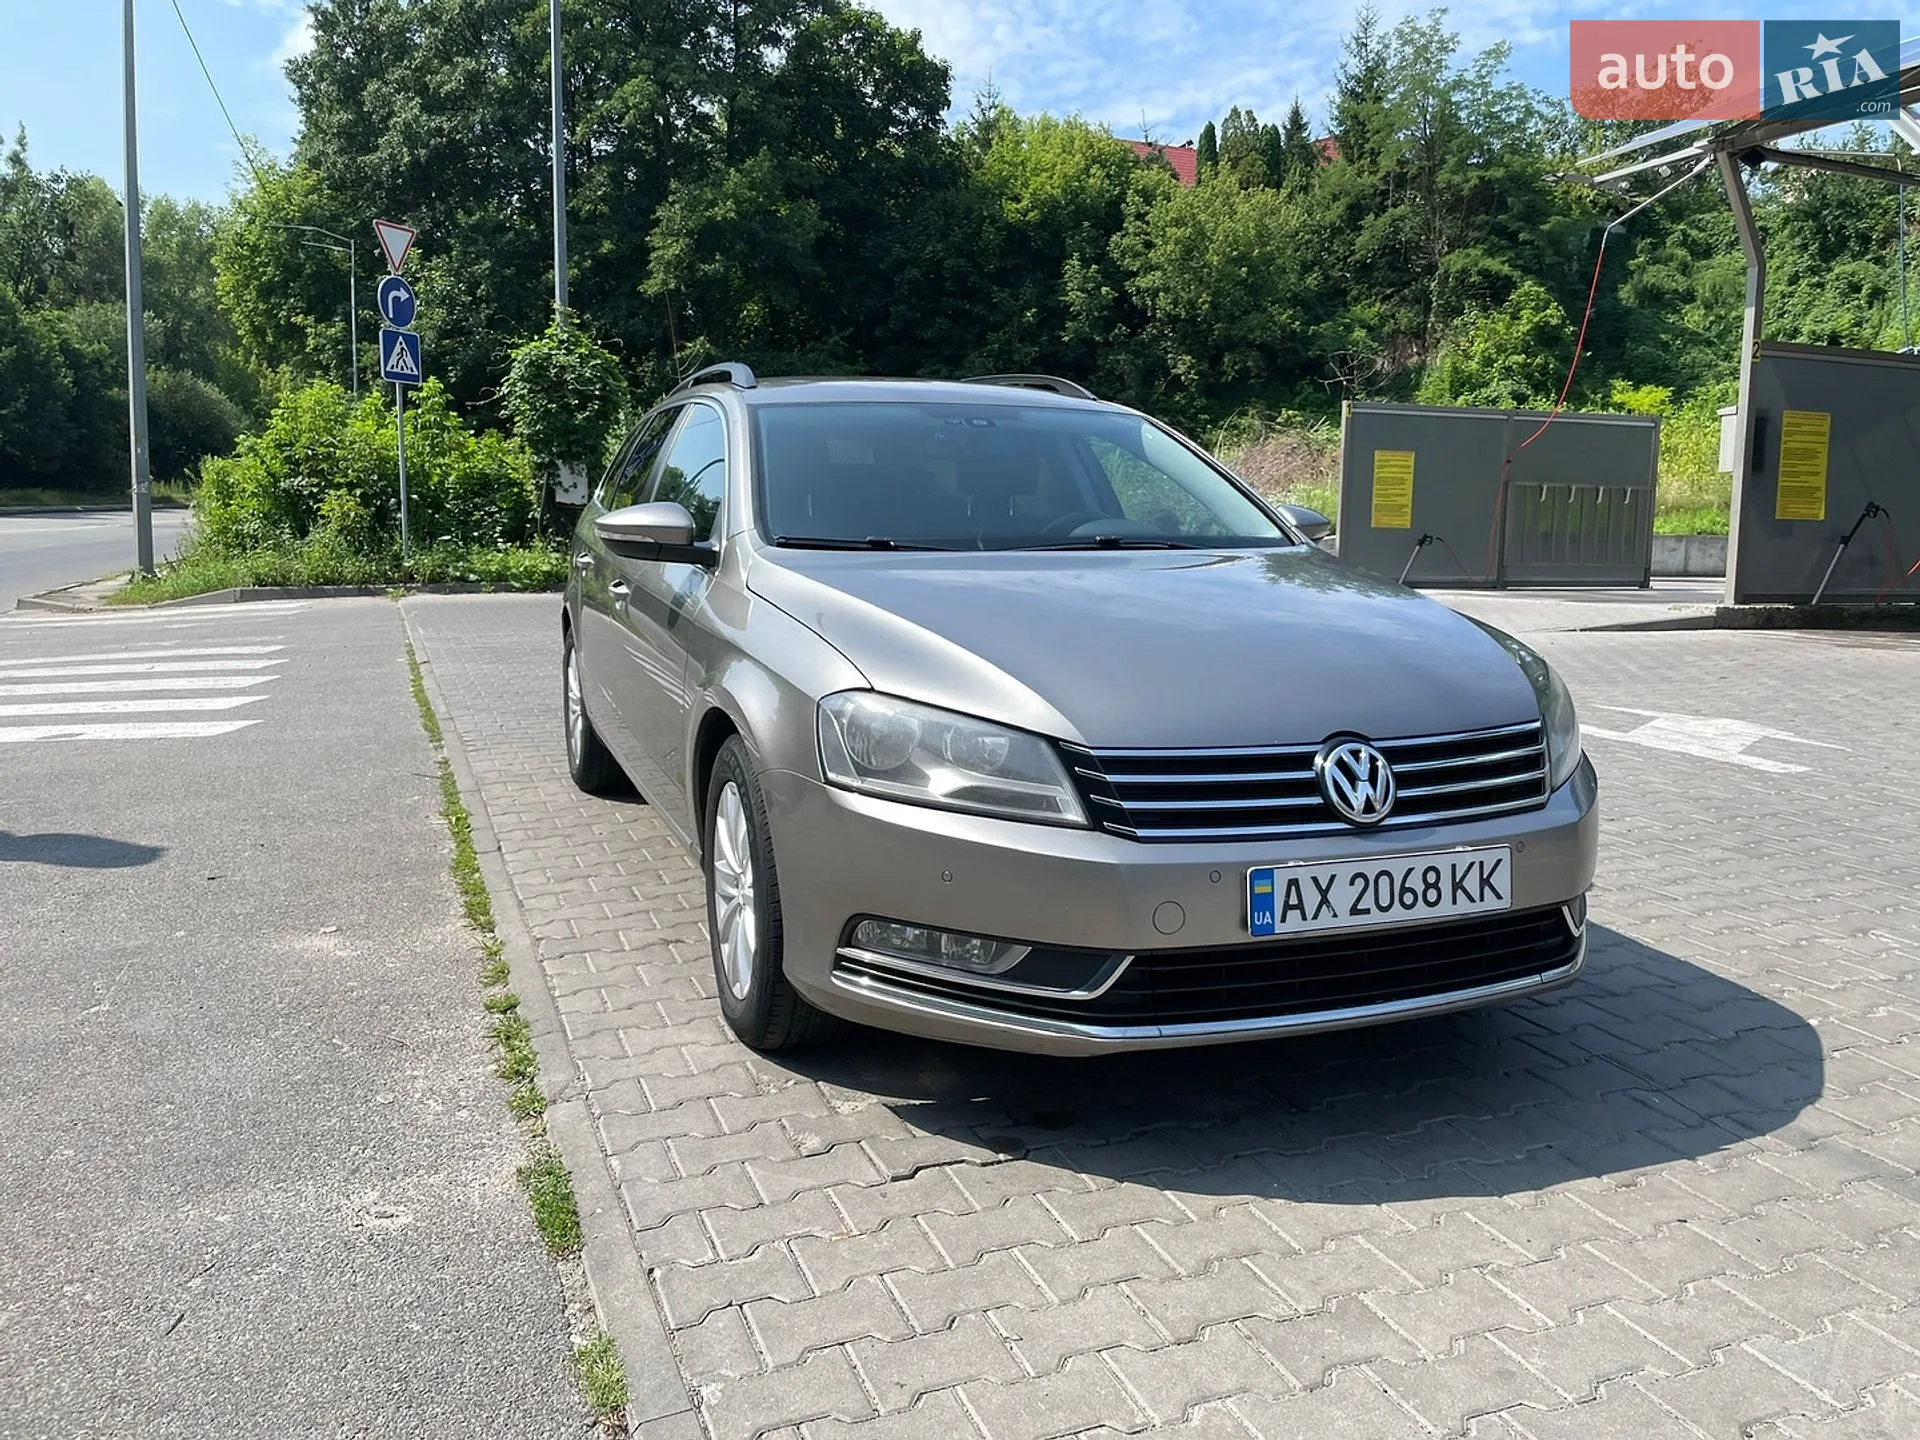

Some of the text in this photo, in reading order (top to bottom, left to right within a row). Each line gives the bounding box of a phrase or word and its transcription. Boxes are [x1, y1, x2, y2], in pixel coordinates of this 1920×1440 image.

[1751, 341, 1760, 360] 2
[1325, 743, 1392, 822] VW
[1254, 858, 1503, 925] UA AX 2068 KK
